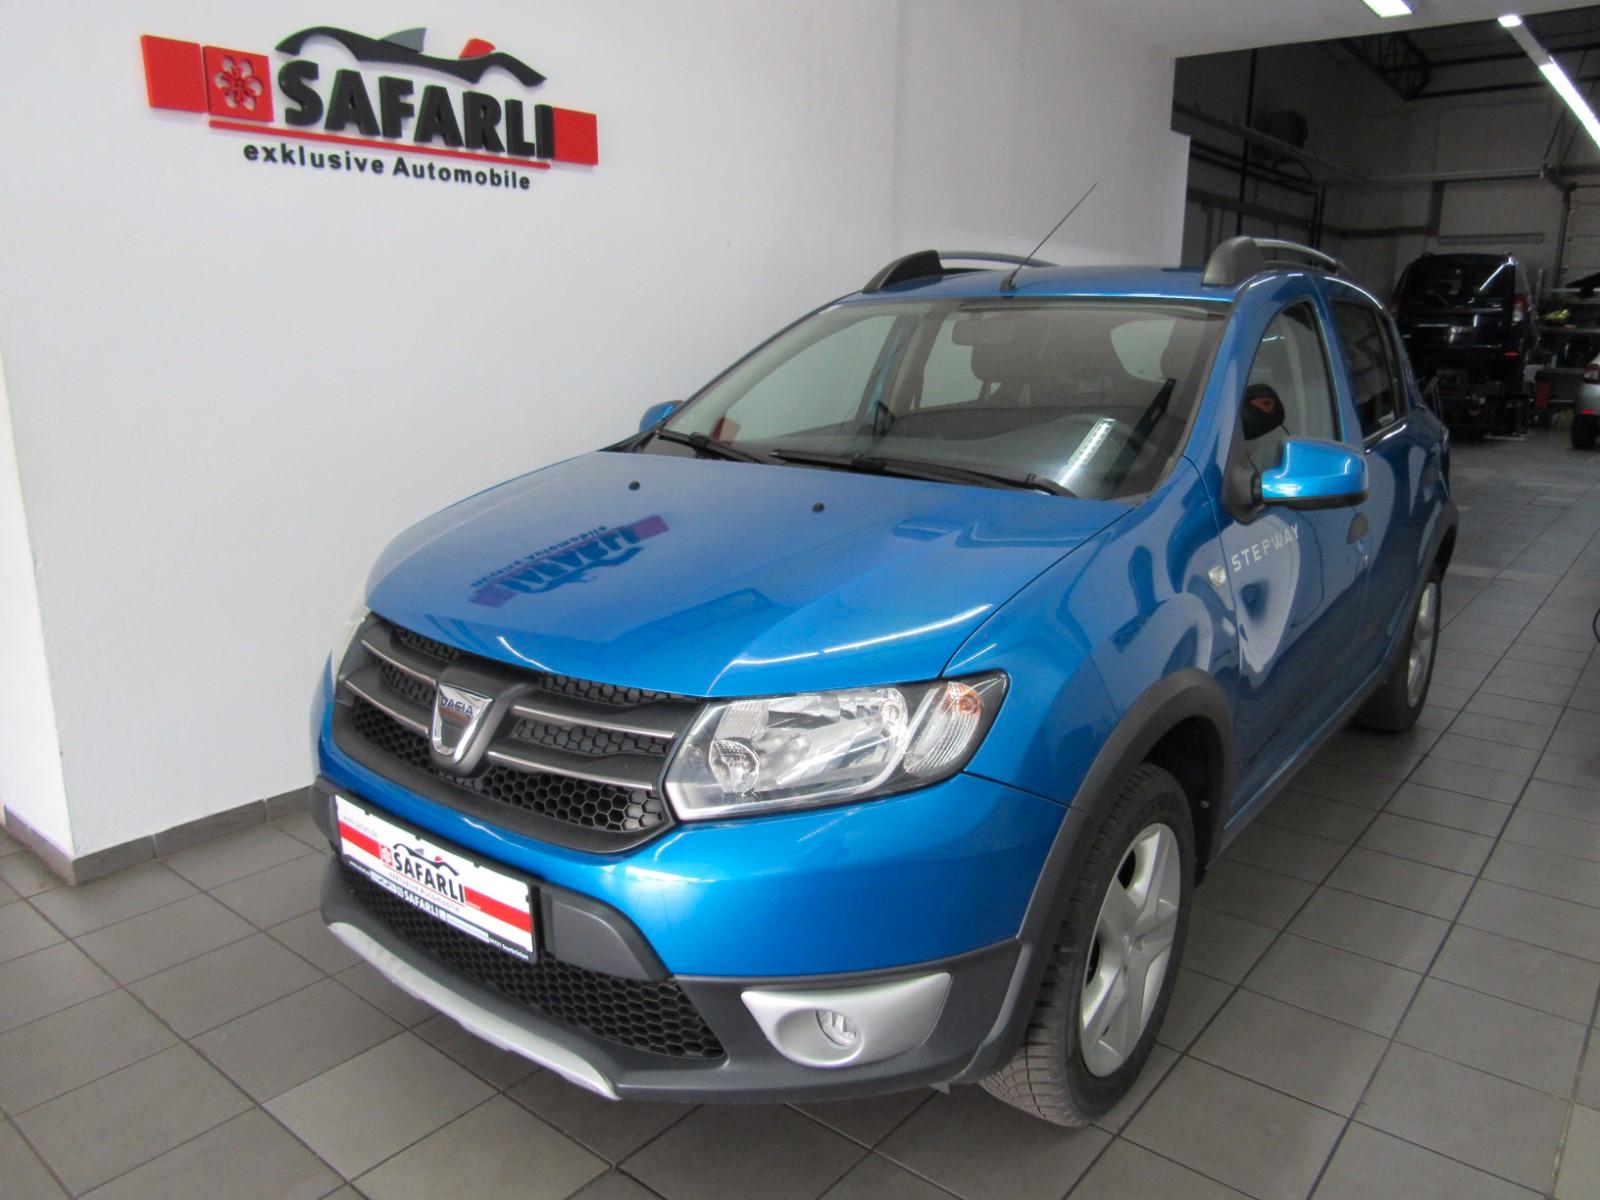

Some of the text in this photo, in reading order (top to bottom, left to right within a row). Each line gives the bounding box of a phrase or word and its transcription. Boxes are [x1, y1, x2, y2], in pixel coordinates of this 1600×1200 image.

[277, 59, 556, 159] SAFARLI
[243, 142, 531, 190] exklusive Automobile
[1231, 523, 1299, 572] STEPWAY
[440, 696, 474, 716] DACIA
[393, 852, 465, 904] SAFARLI
